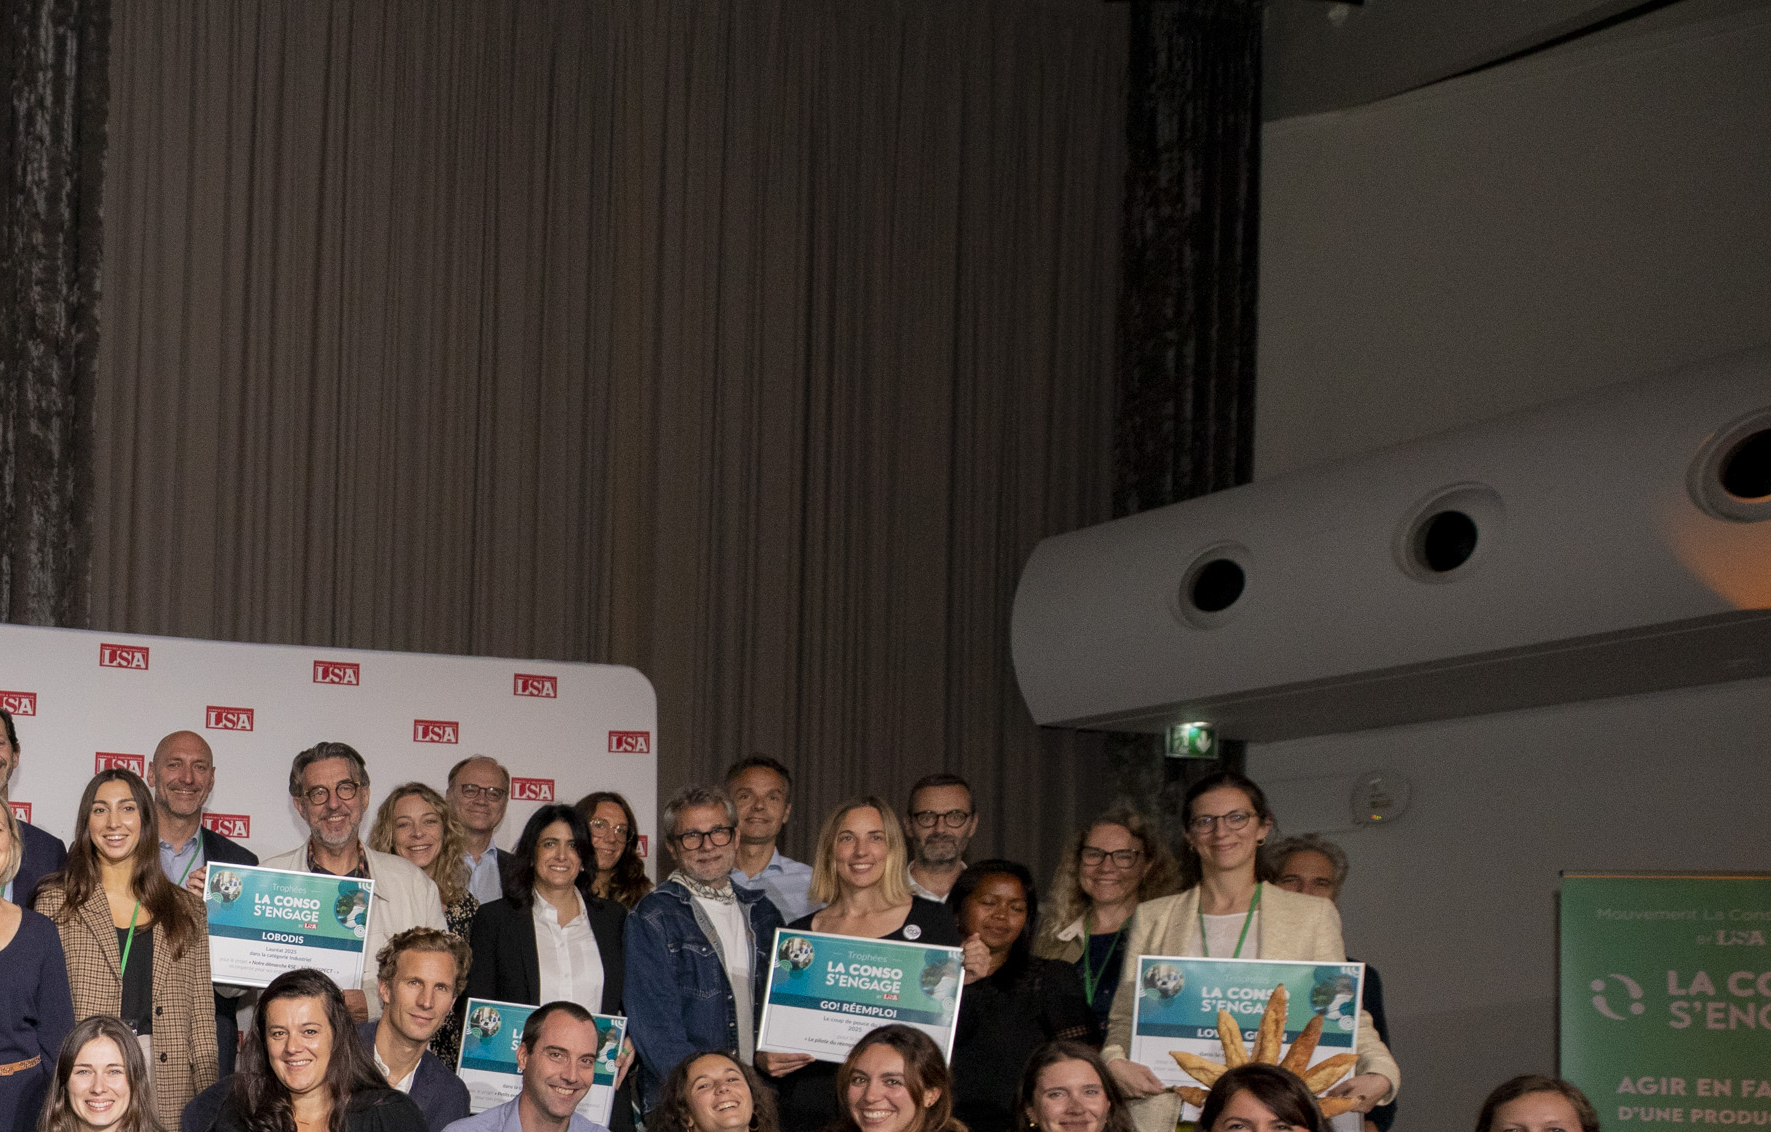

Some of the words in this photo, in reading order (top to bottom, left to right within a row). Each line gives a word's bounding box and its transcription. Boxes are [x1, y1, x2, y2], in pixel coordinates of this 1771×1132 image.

[102, 649, 147, 669] LSA
[315, 664, 358, 685] LSA
[517, 678, 556, 697] LSA
[208, 711, 252, 730] LSA
[416, 724, 457, 743] LSA
[611, 735, 648, 753] LSA
[513, 782, 554, 801] LSA
[255, 893, 270, 904] LA
[274, 896, 320, 909] CONSO
[253, 905, 319, 922] S'ENGAGE
[262, 932, 304, 944] LOBODIS
[827, 961, 845, 973] LA
[849, 964, 903, 980] CONSO
[826, 973, 901, 993] S'ENGAGE
[1667, 970, 1716, 996] LA
[820, 1001, 840, 1010] GO!
[1616, 1076, 1686, 1096] AGIR
[1697, 1078, 1732, 1097] EN
[1618, 1106, 1684, 1122] D'UNE
